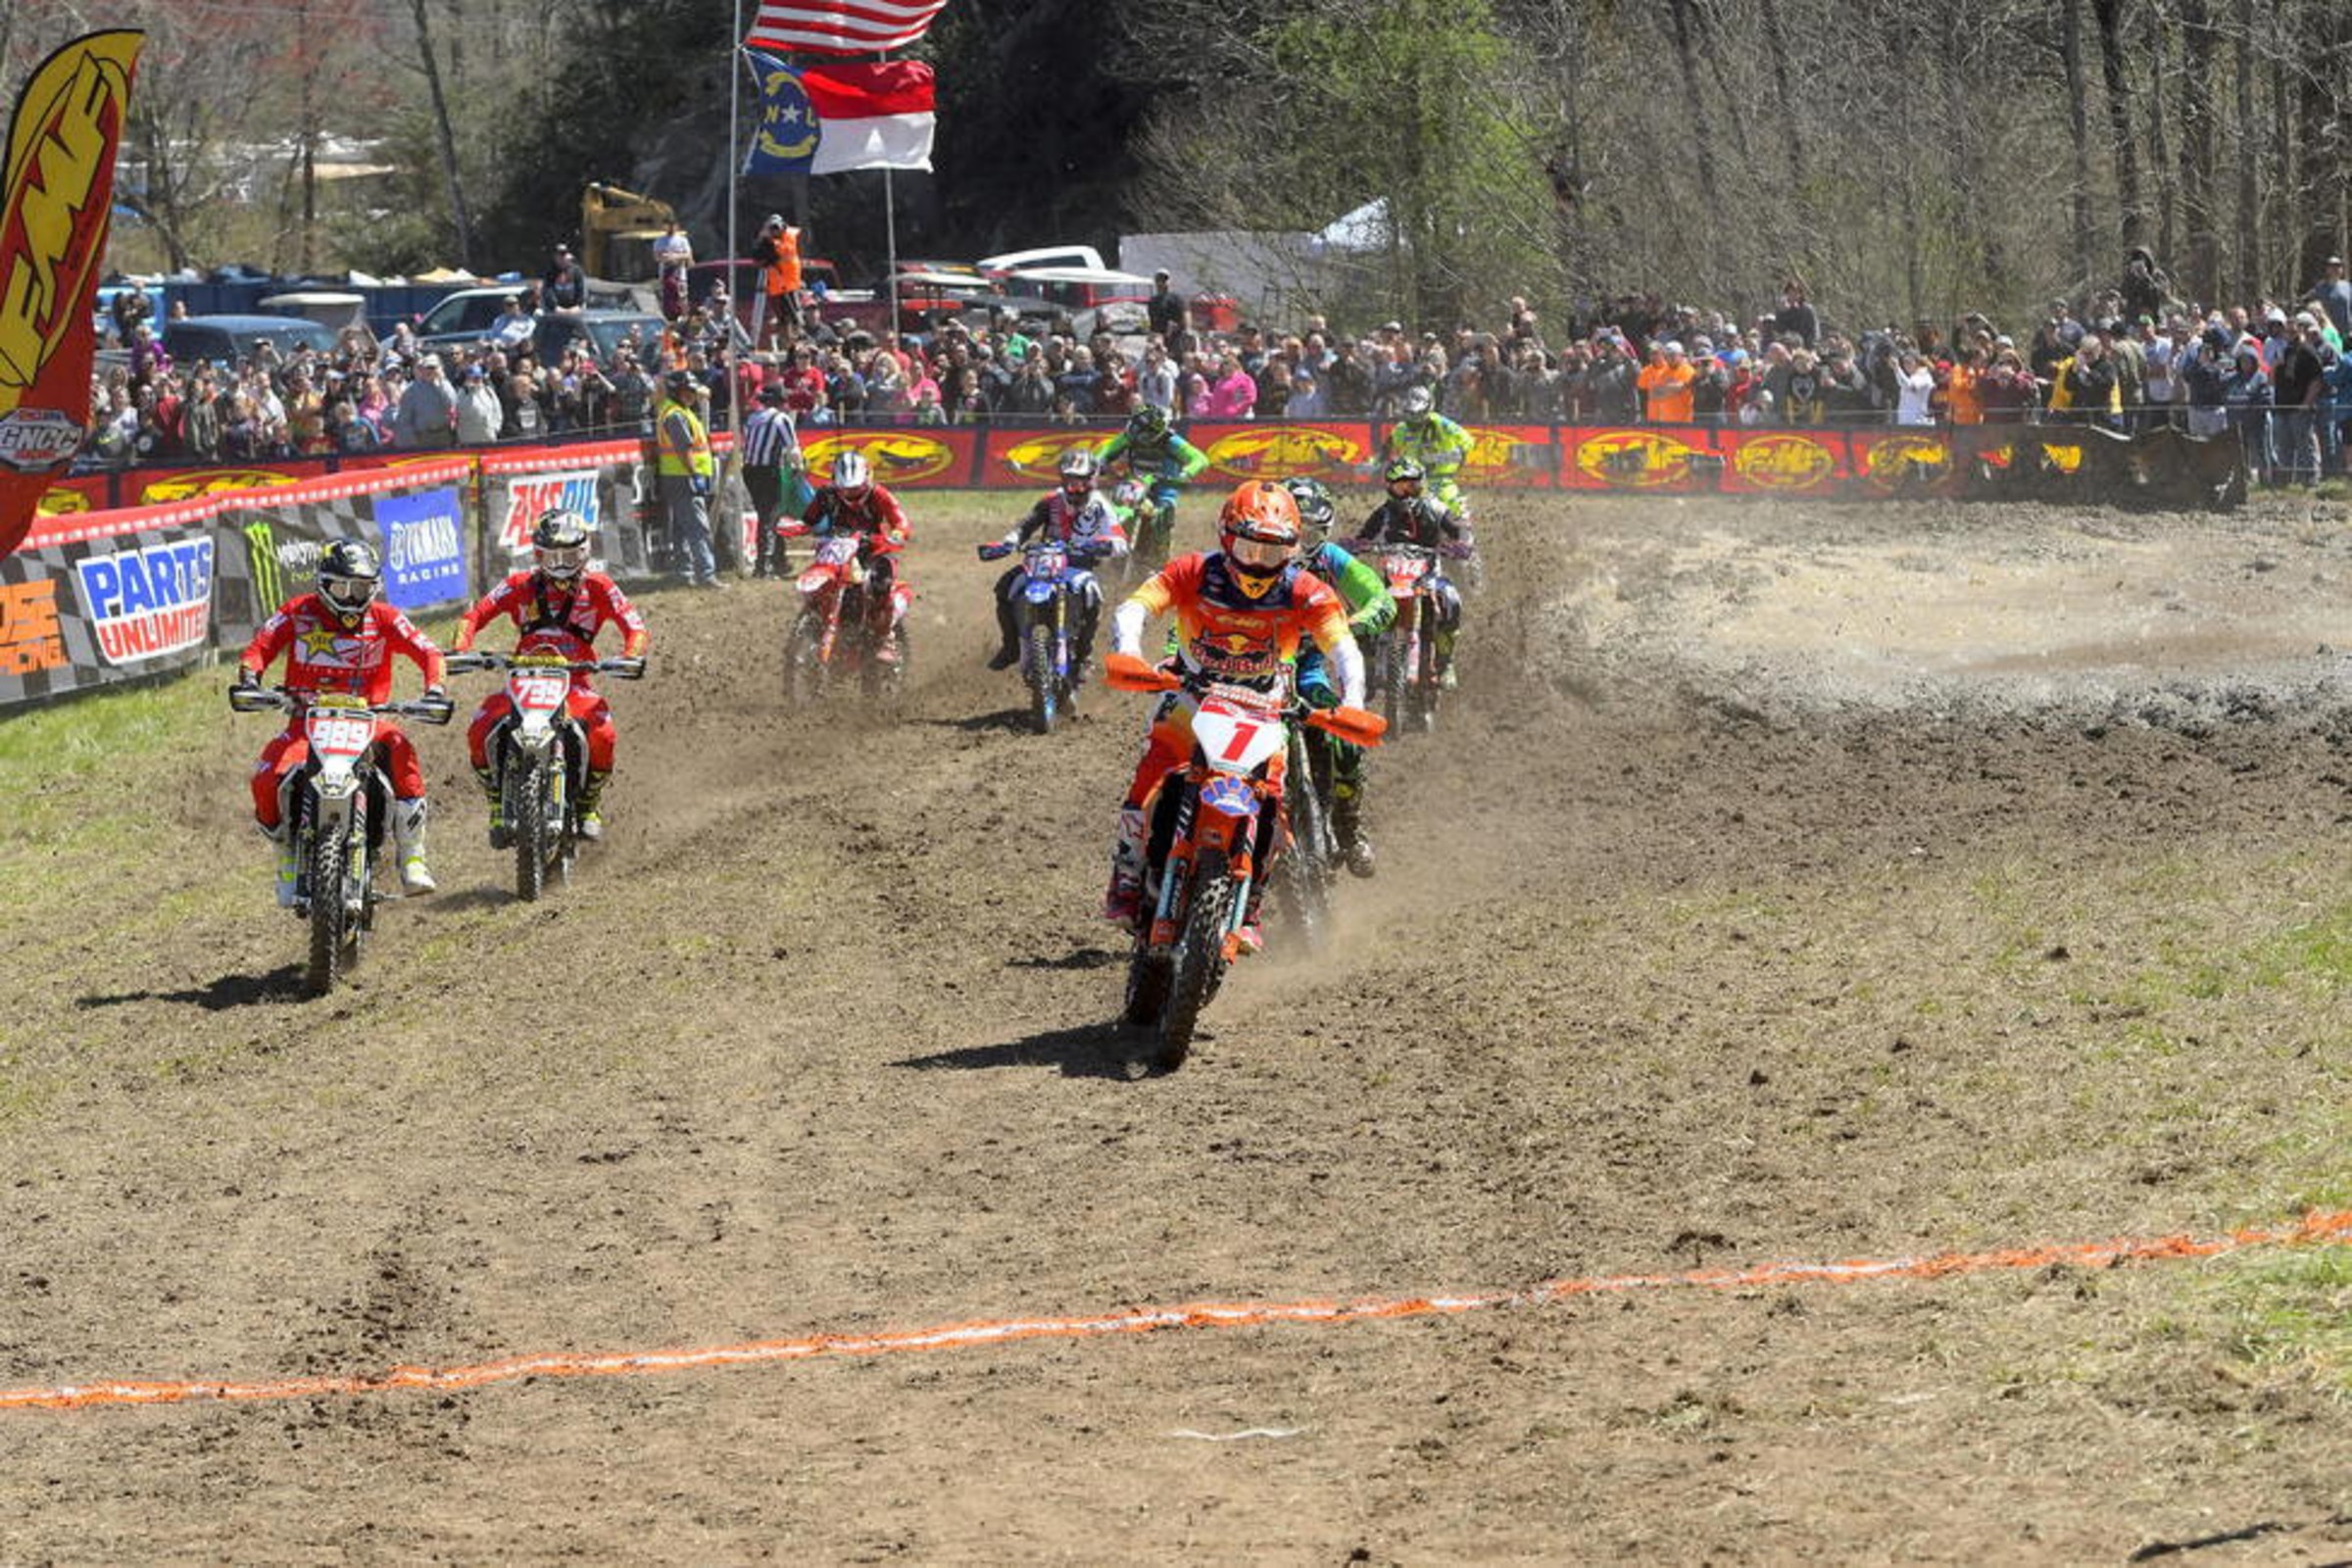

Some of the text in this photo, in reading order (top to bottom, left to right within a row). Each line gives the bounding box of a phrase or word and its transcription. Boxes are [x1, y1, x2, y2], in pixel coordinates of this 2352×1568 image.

[80, 541, 212, 619] PARTS
[398, 564, 459, 584] RACING
[99, 602, 209, 658] UNLIMITE
[1221, 721, 1258, 761] 1
